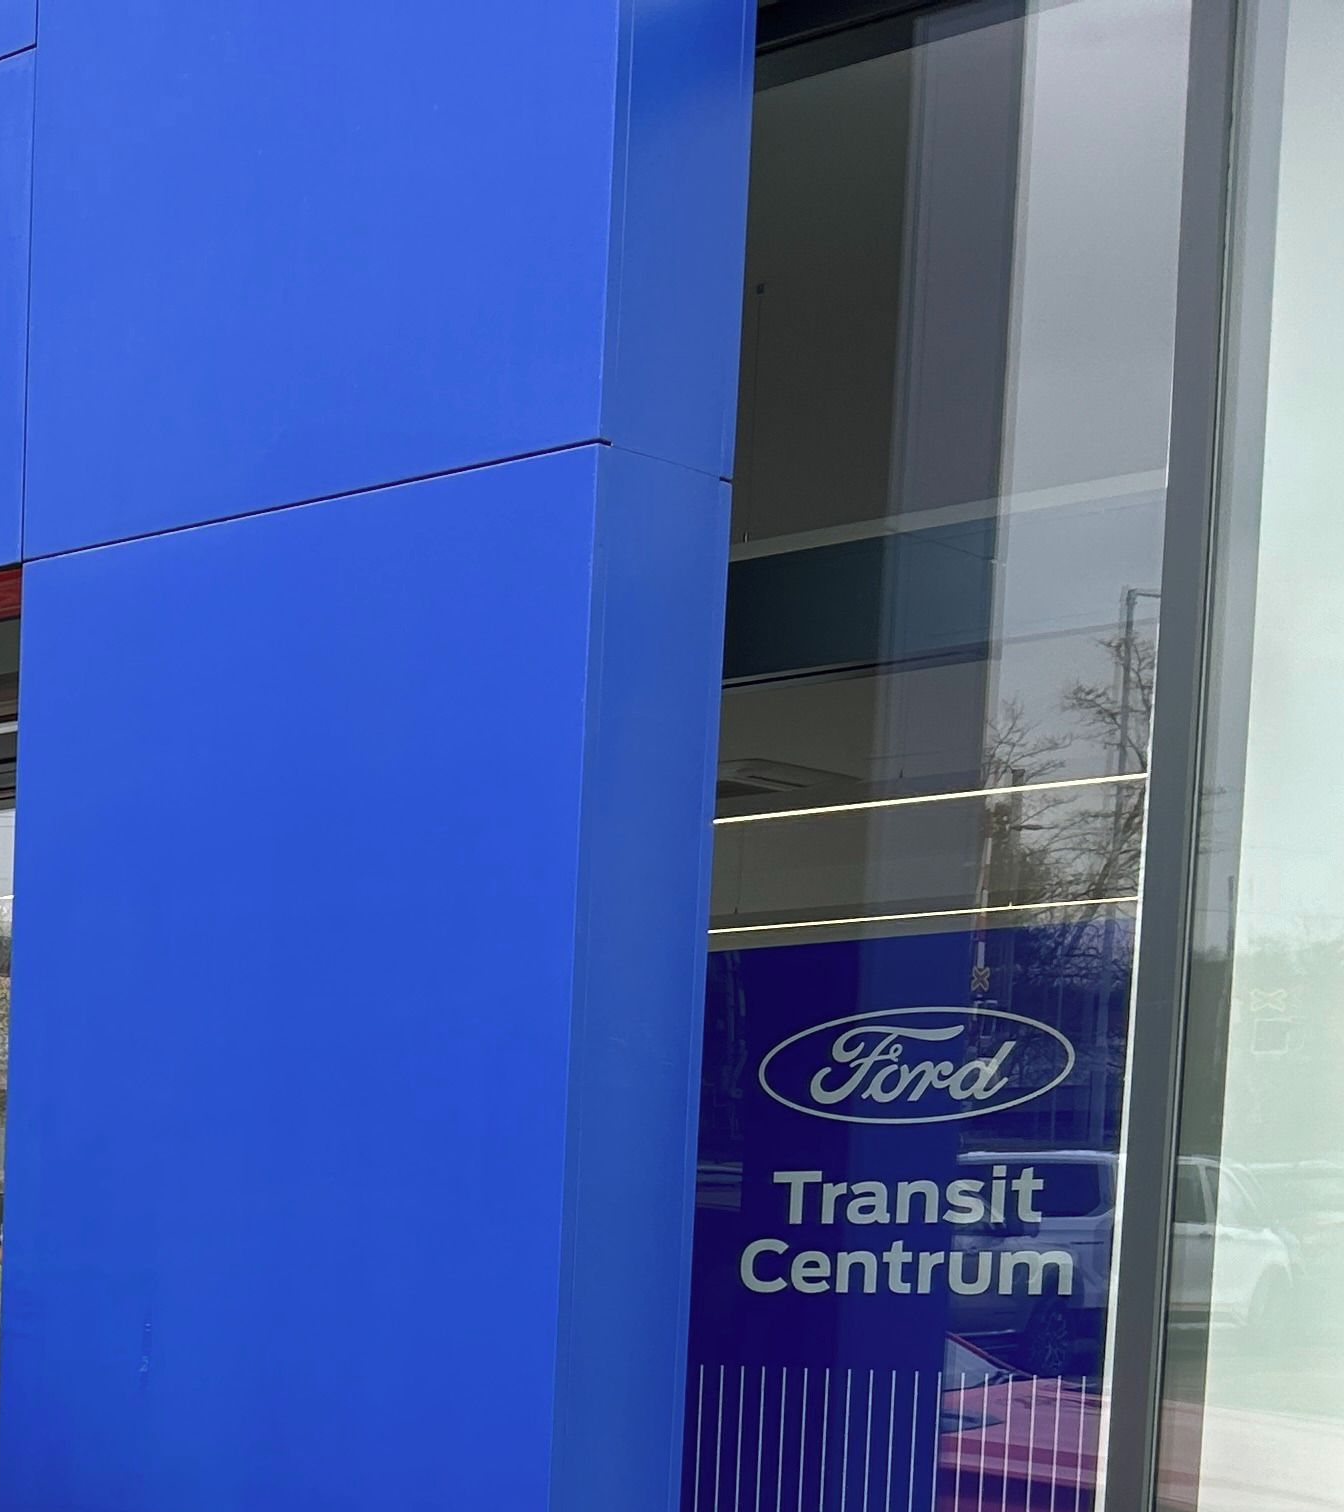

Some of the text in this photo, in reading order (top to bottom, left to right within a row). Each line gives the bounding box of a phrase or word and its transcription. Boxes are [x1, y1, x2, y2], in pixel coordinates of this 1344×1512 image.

[809, 1023, 1016, 1105] Ford
[772, 1164, 1045, 1226] Transit
[739, 1238, 1074, 1296] Centrum
